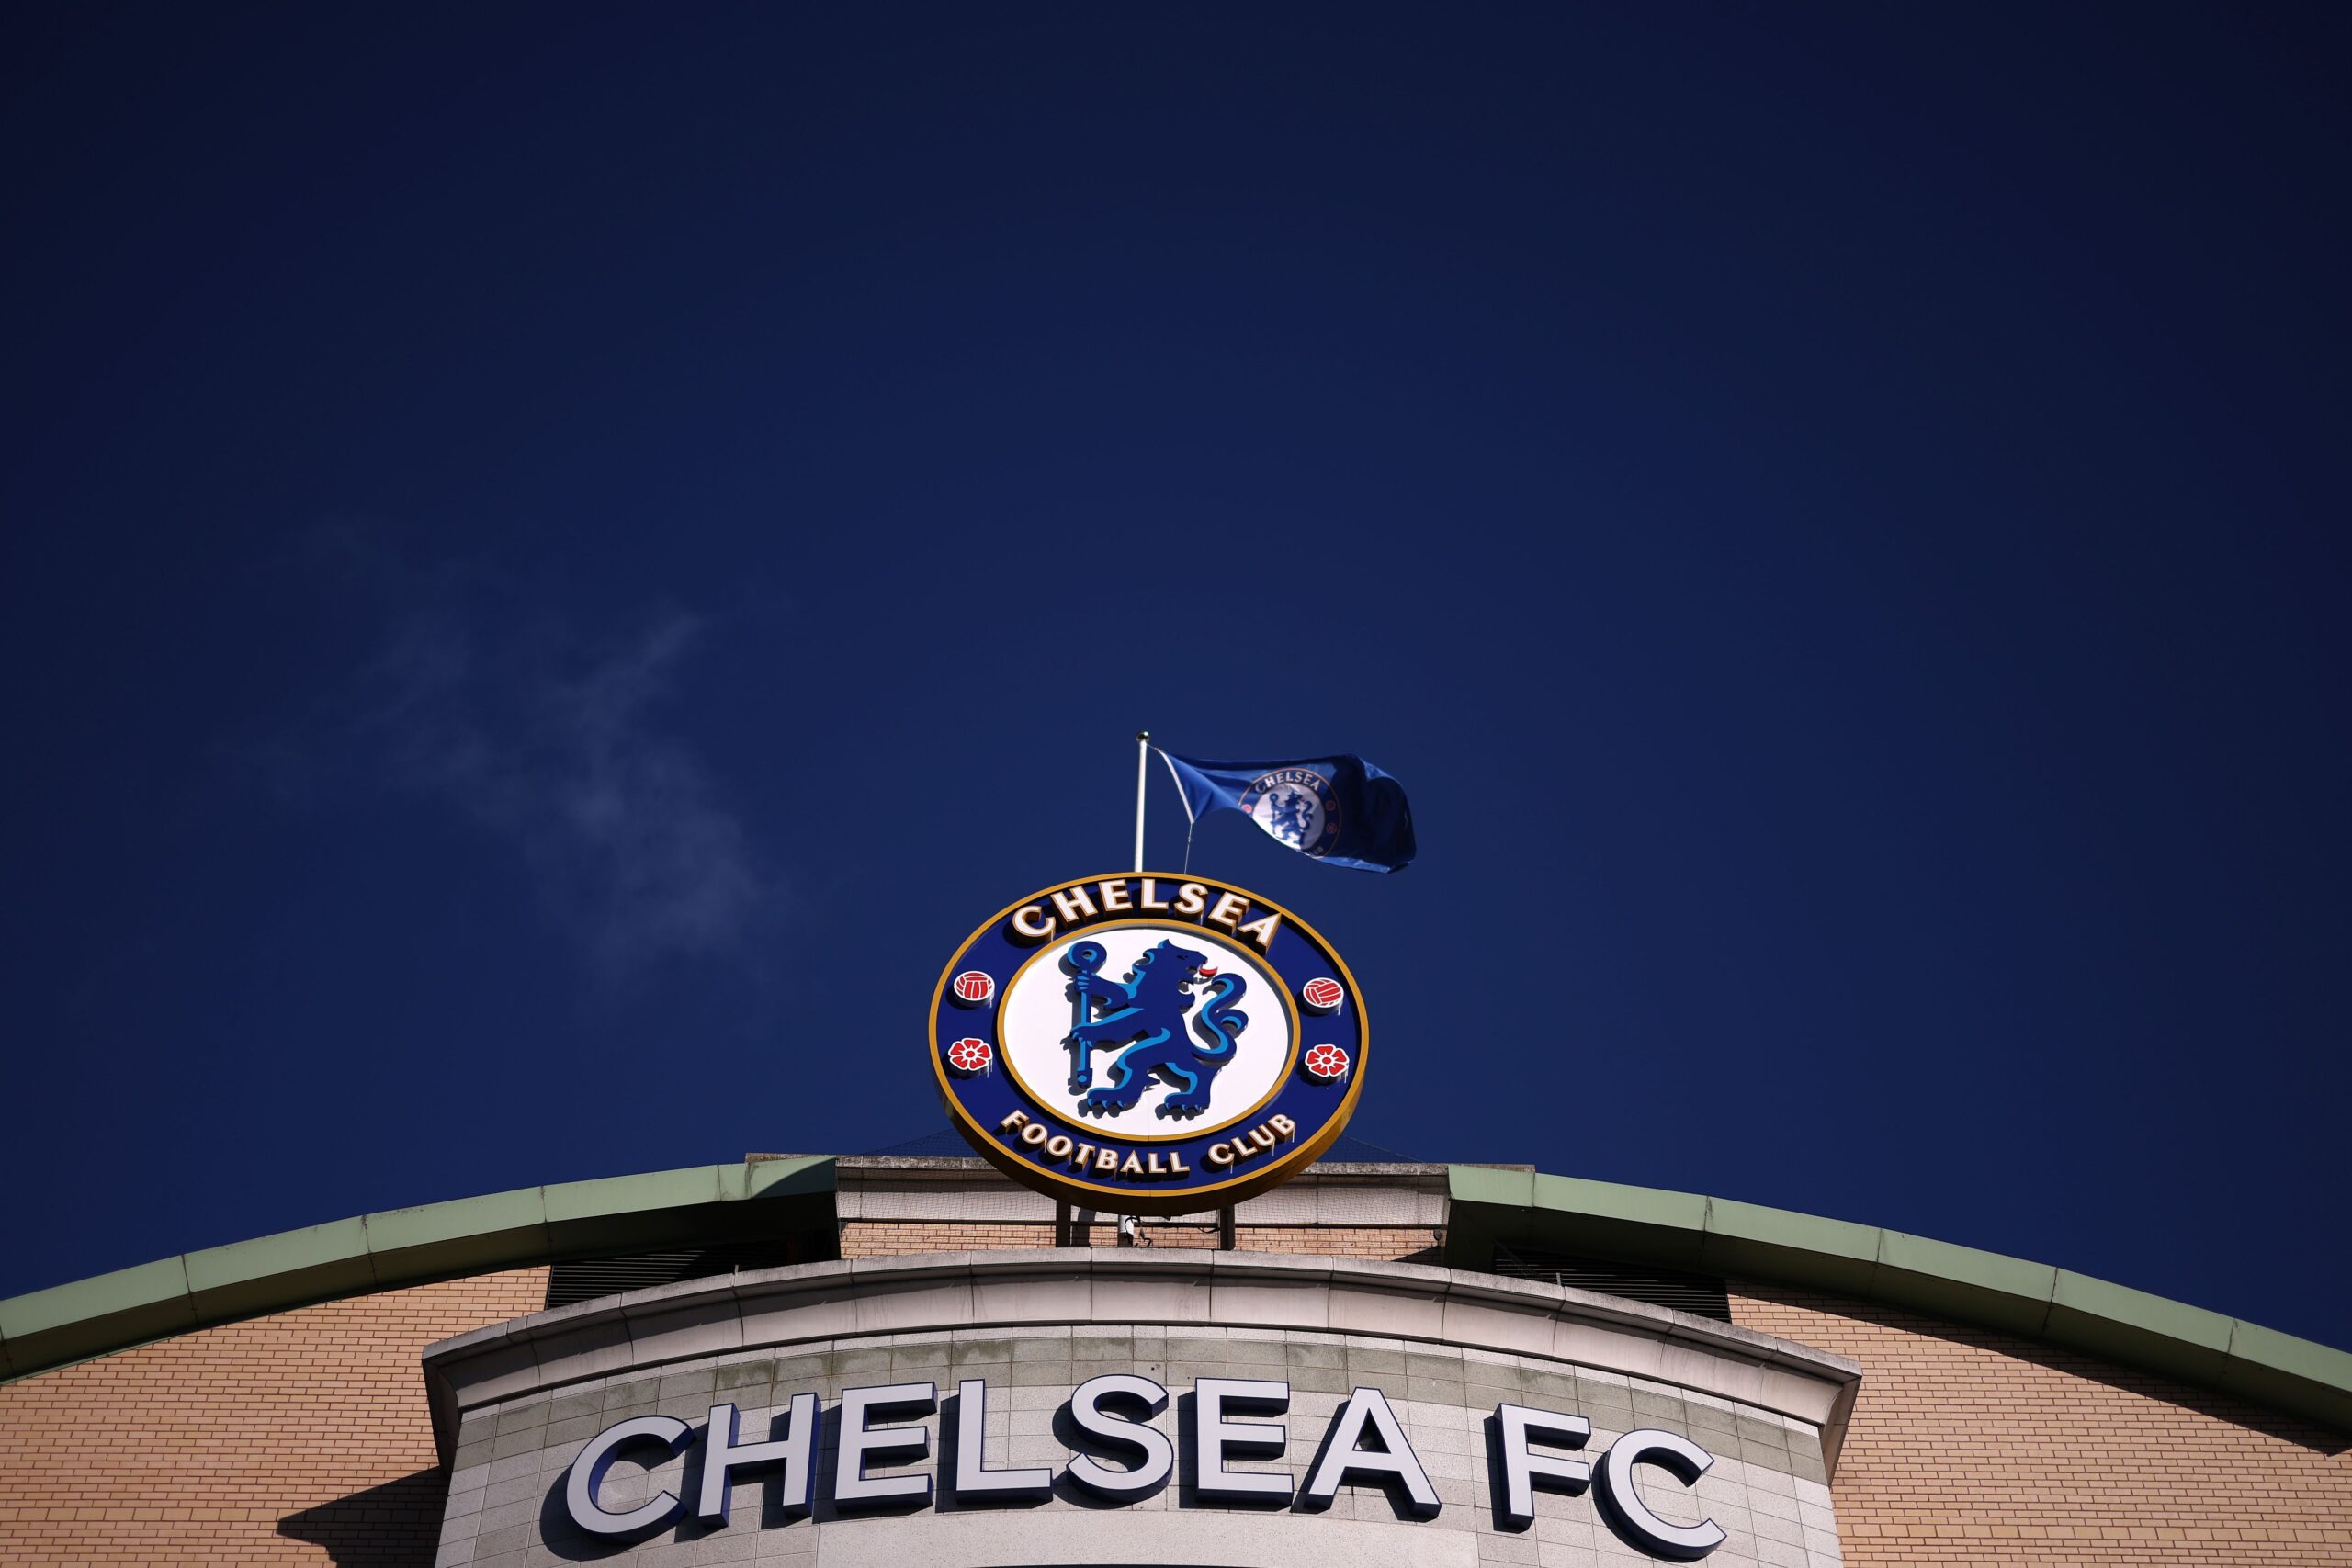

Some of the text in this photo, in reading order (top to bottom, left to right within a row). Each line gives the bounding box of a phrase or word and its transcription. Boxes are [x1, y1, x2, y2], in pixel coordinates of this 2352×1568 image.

[1256, 771, 1320, 793] CHELSEA
[1012, 878, 1281, 950] CHELSEA
[1000, 1109, 1296, 1175] FOOTBALL CLUB
[564, 1374, 1728, 1558] CHELSEA FC
